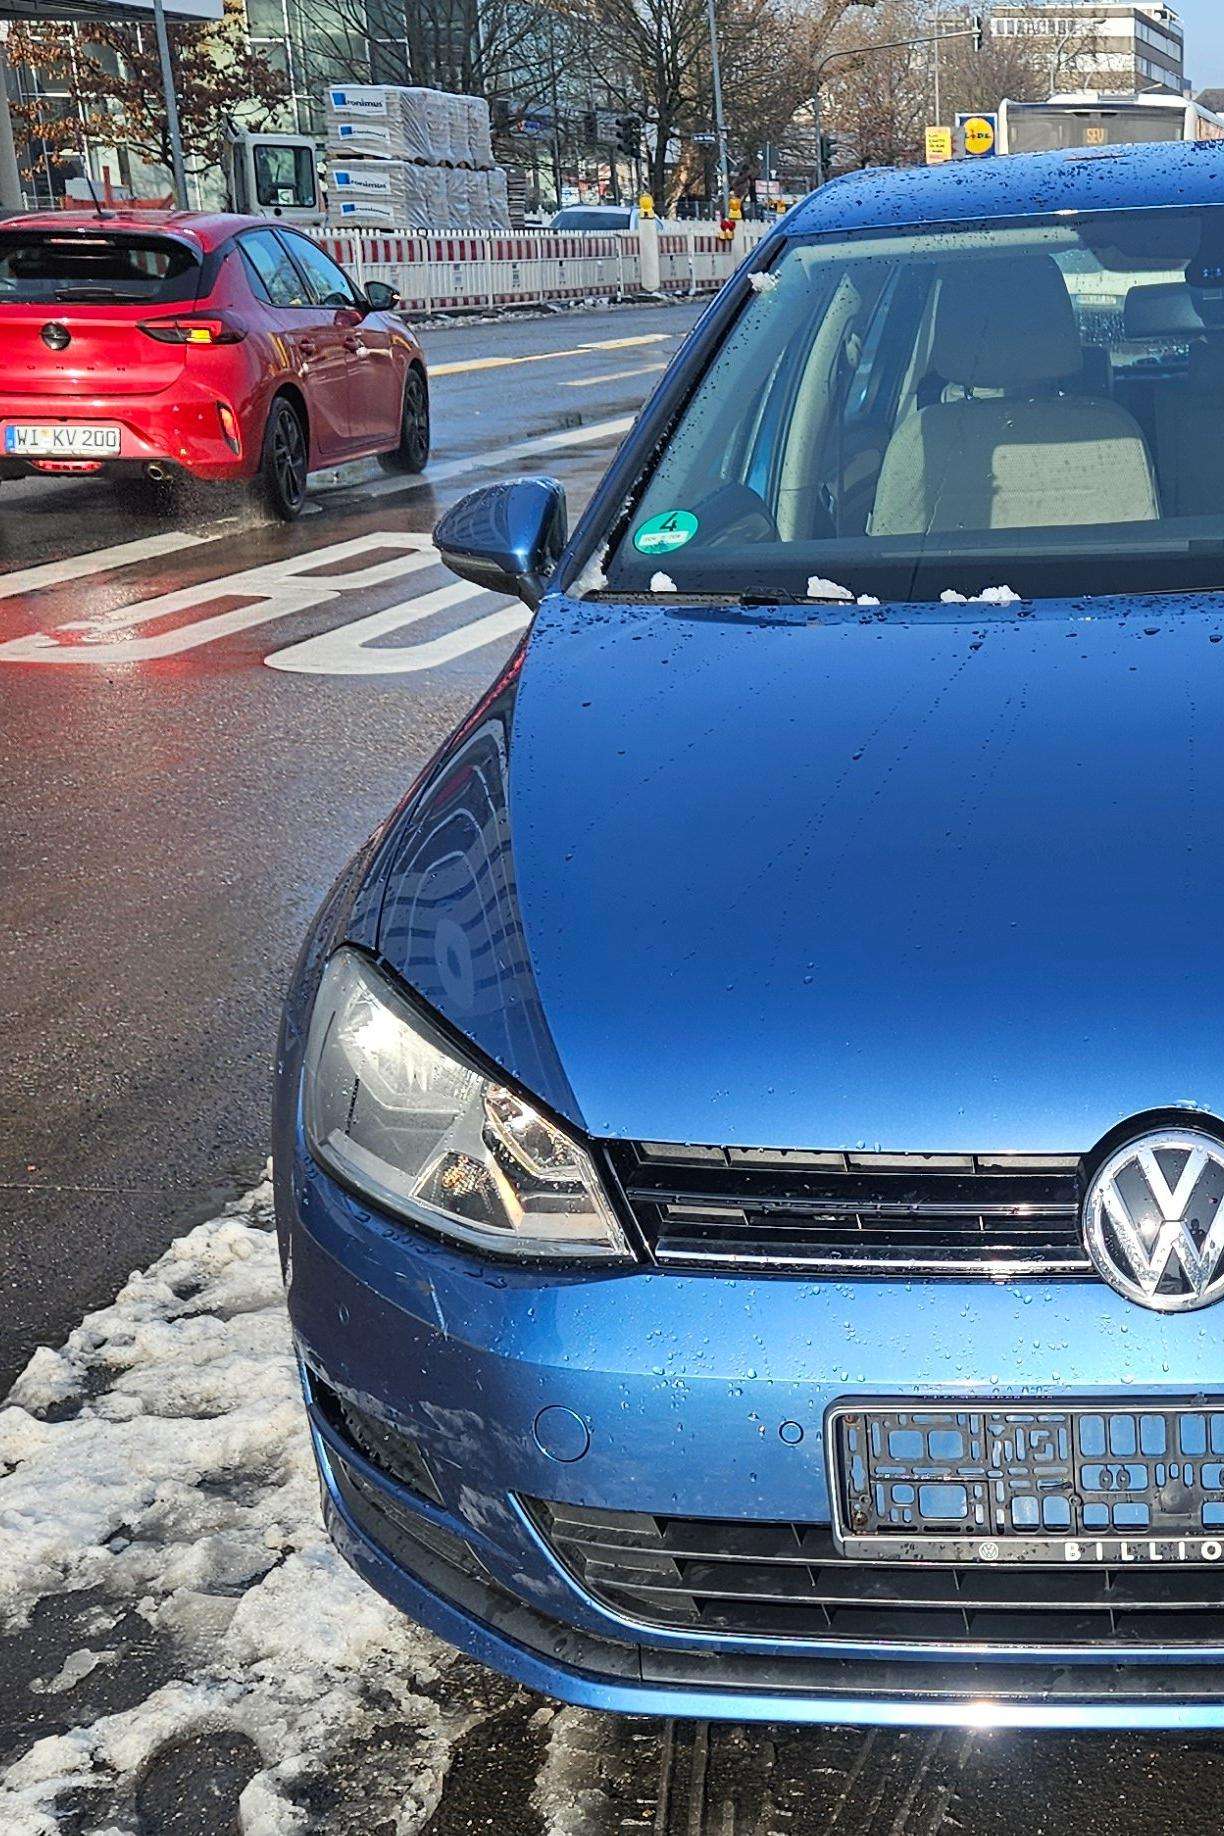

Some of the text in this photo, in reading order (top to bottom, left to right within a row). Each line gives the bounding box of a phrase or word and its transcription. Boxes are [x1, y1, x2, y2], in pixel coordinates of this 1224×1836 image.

[17, 429, 117, 447] WI KV 200
[659, 512, 678, 531] 4
